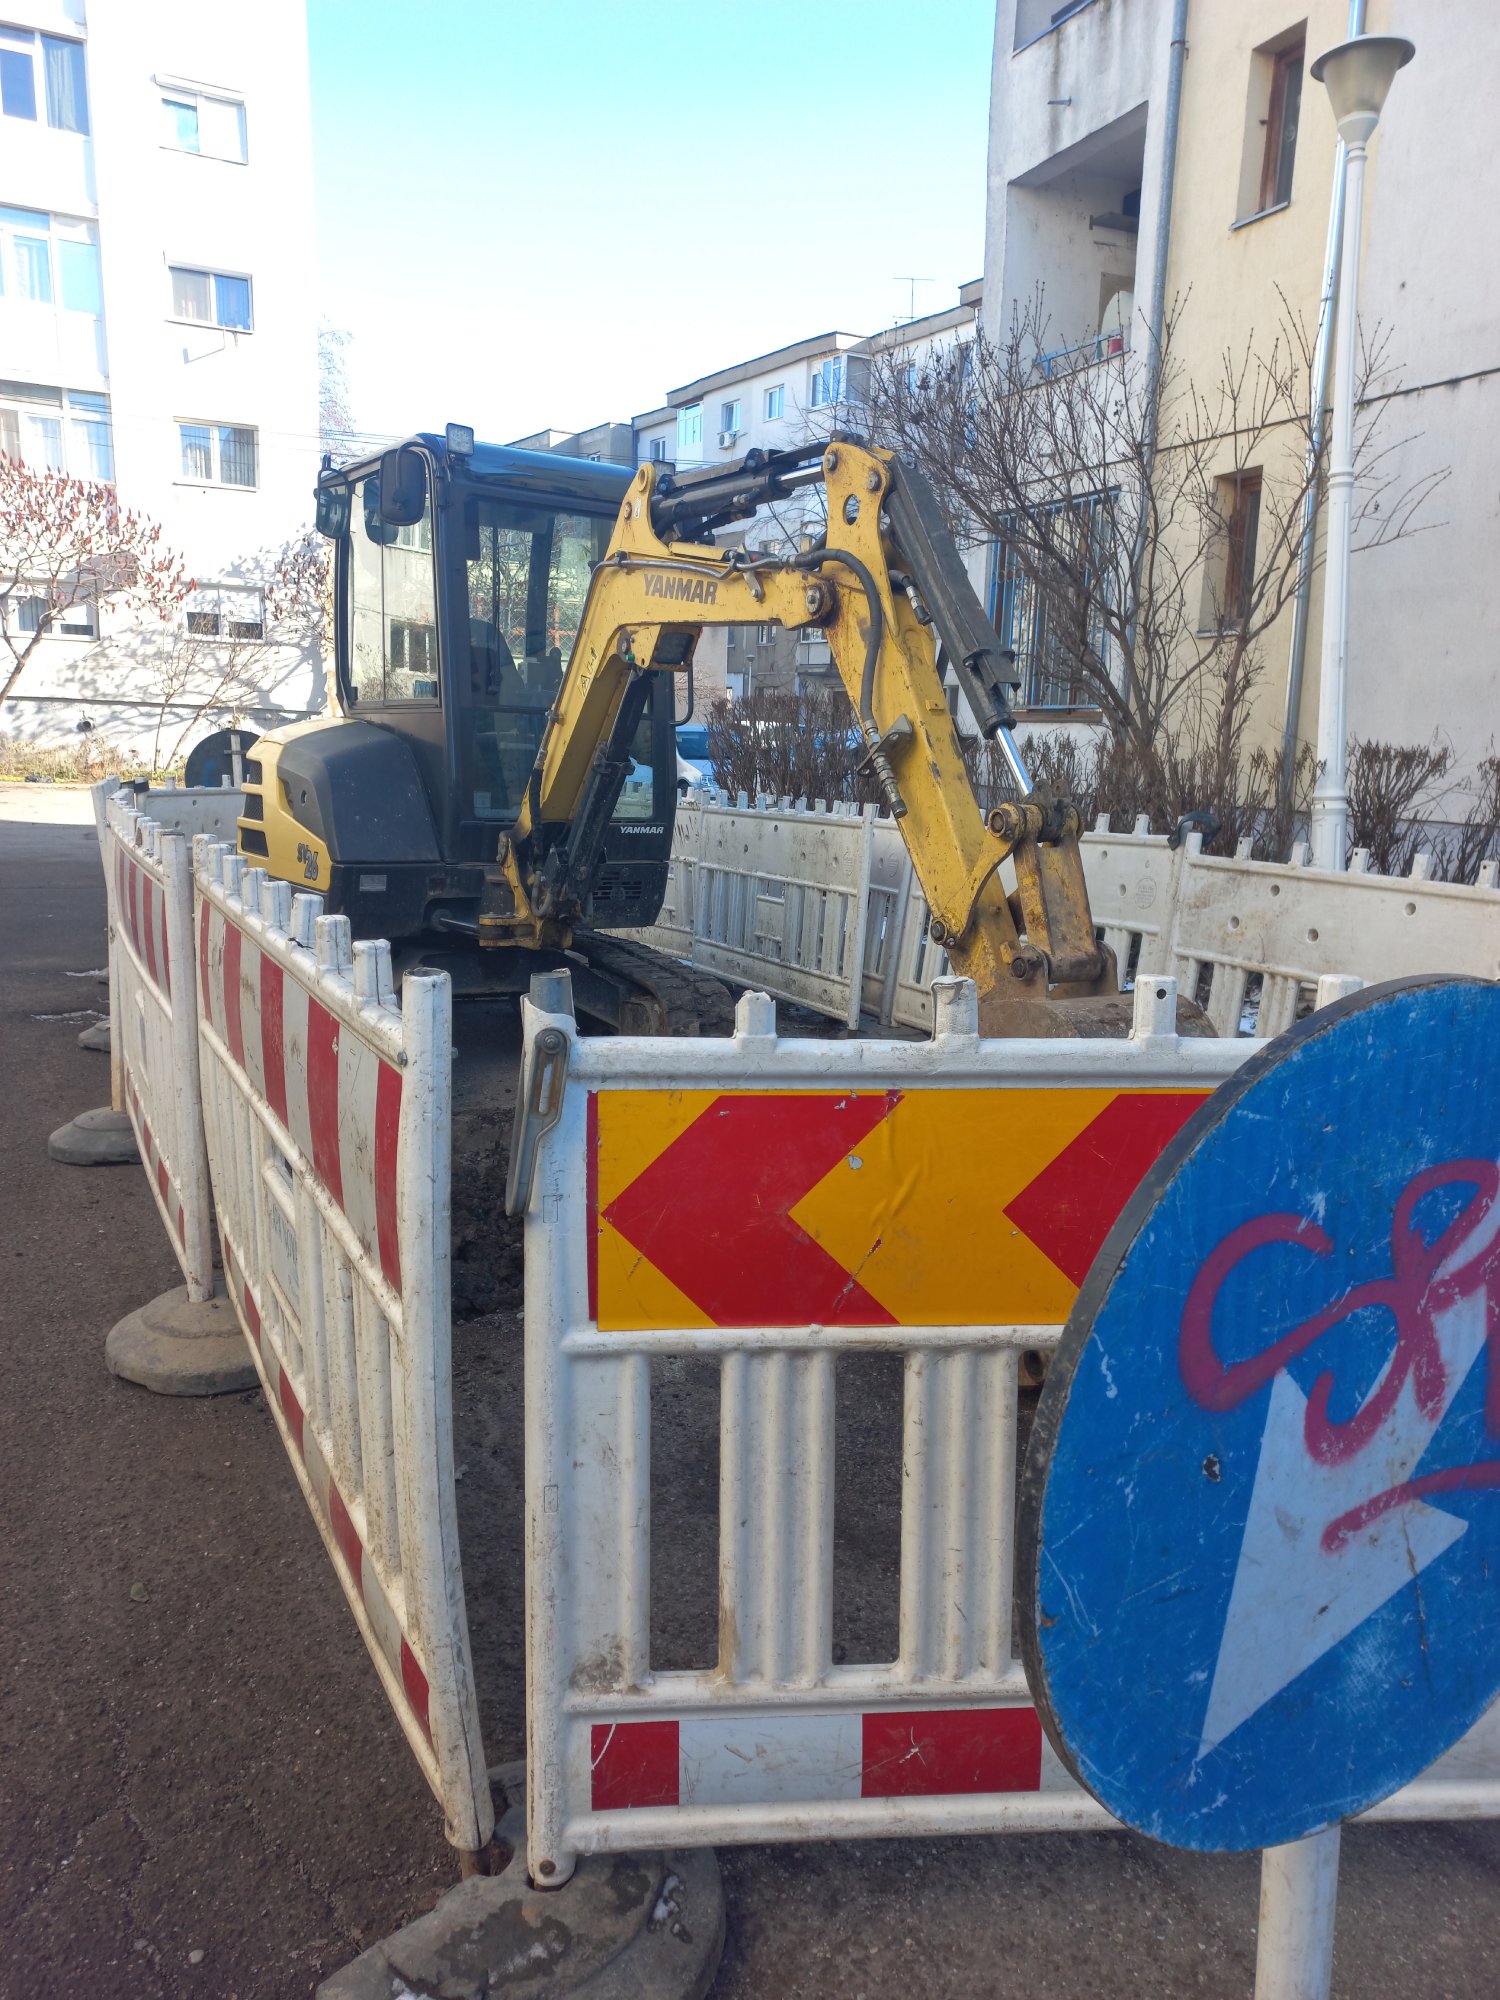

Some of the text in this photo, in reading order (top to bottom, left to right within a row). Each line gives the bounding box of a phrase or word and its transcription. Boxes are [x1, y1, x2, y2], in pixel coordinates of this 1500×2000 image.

[643, 573, 718, 605] YANMAR
[620, 826, 664, 834] YANMAR
[304, 849, 319, 881] 26
